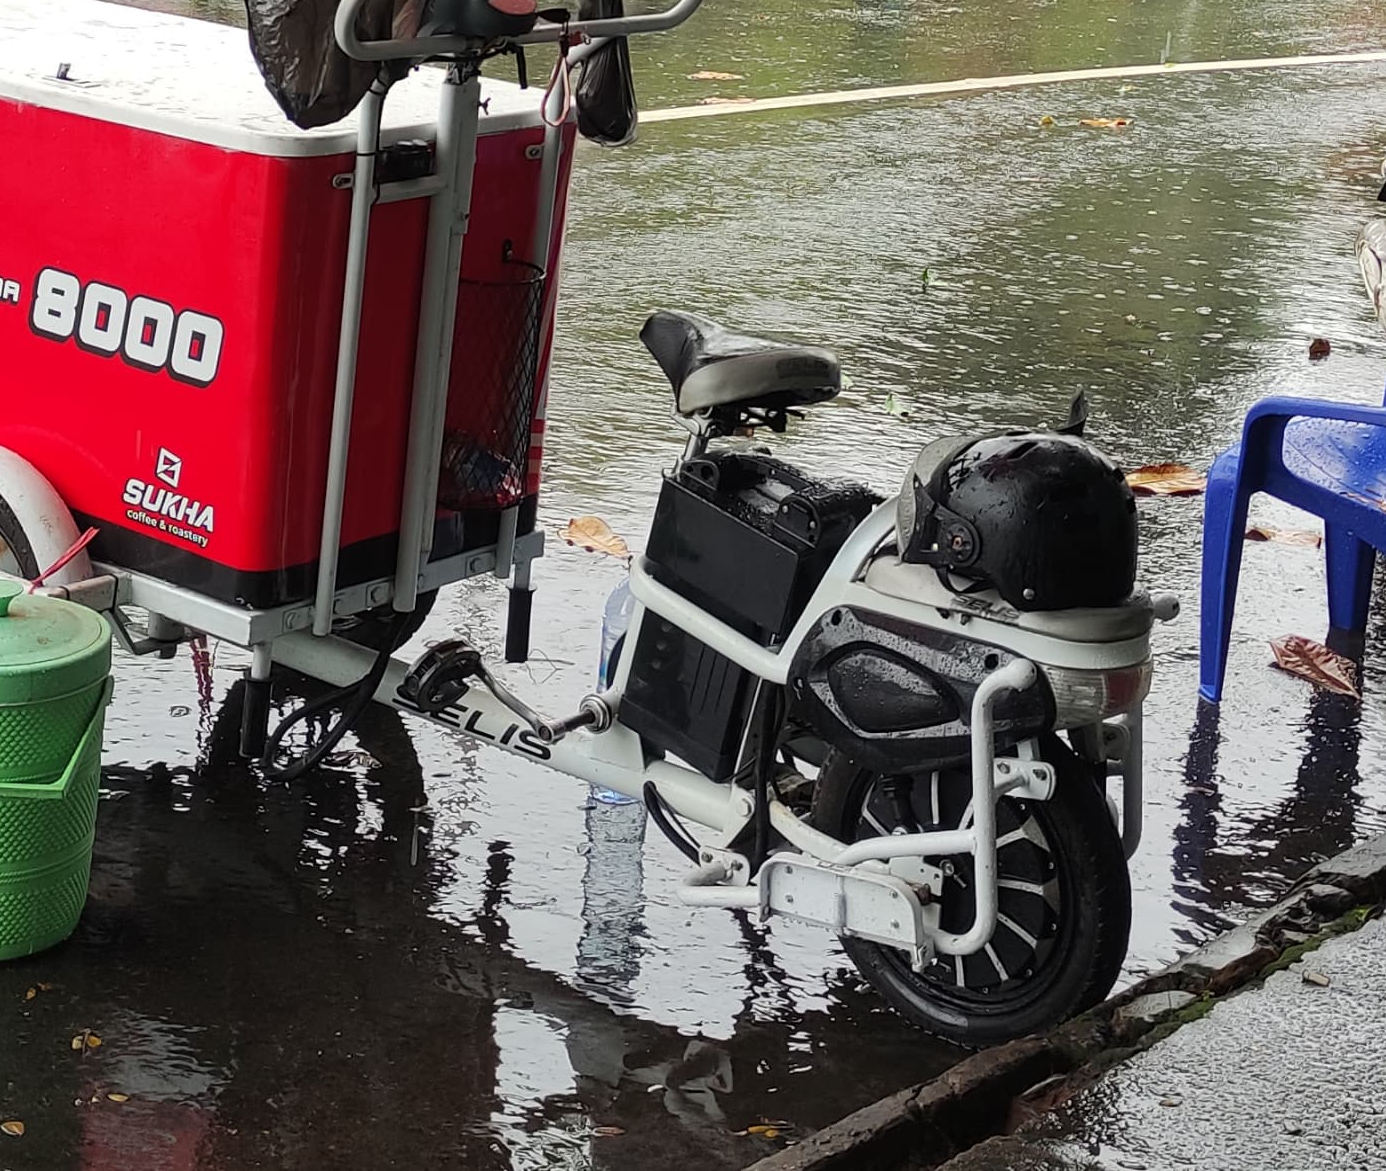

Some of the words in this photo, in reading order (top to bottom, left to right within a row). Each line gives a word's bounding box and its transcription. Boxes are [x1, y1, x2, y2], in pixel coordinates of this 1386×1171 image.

[30, 267, 224, 386] 8000
[122, 477, 215, 533] SUKHA
[126, 509, 158, 527] coffee
[159, 519, 167, 531] &
[168, 524, 209, 548] roastery
